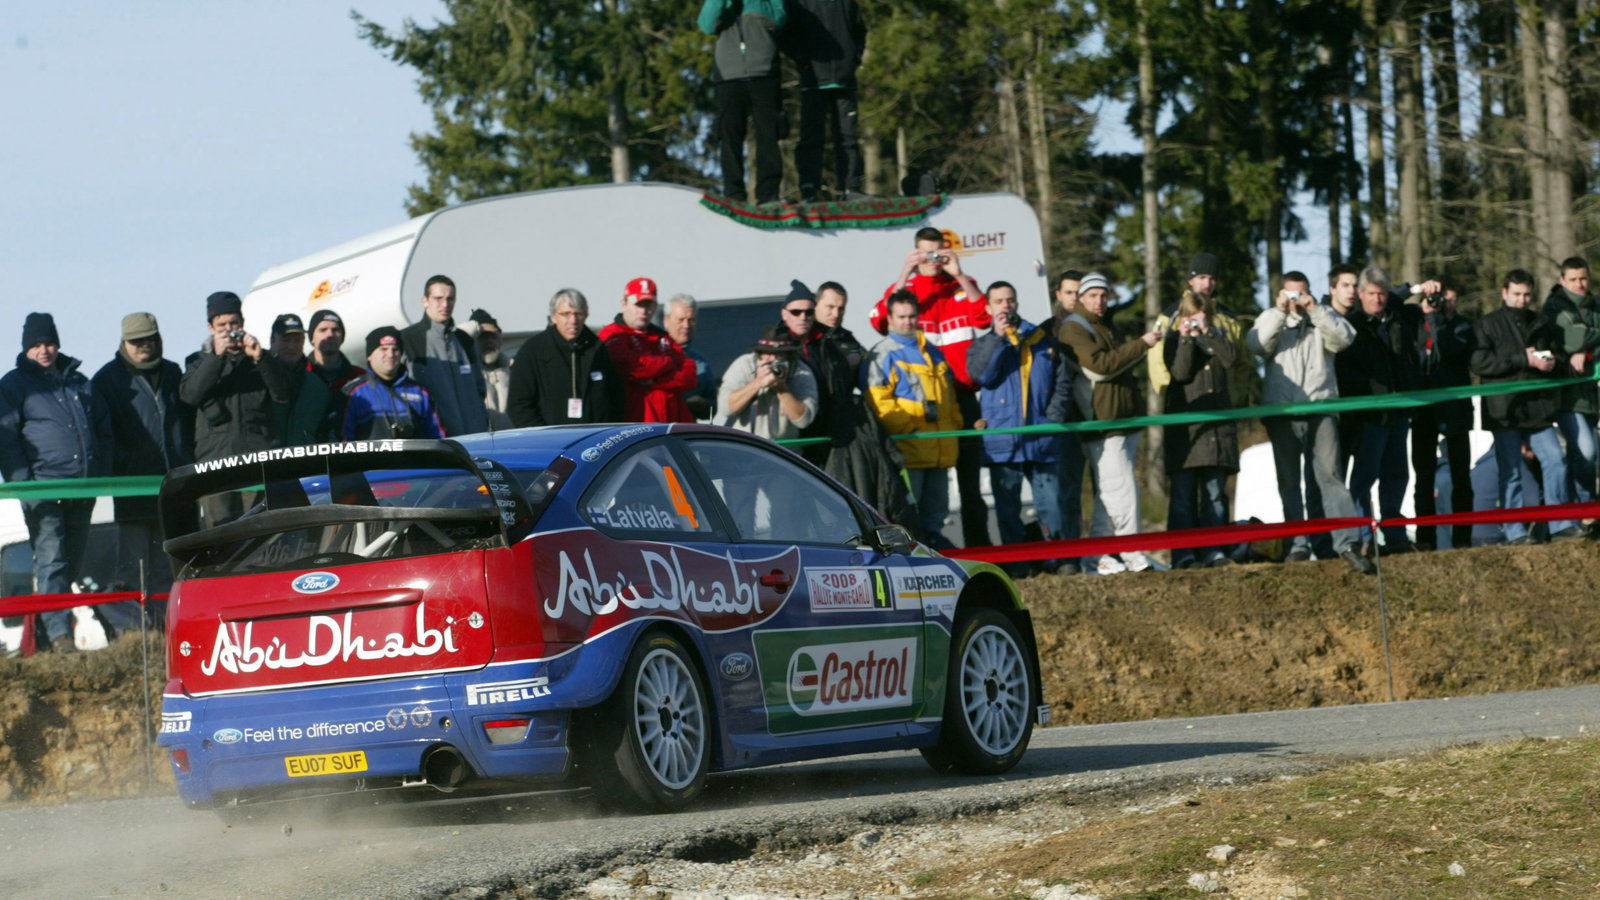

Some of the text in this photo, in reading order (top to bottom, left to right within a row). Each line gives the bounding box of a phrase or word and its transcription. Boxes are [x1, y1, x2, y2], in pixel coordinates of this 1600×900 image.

[942, 231, 1007, 249] S-LIGHT
[313, 274, 360, 300] S-LIGHT
[639, 280, 650, 293] 1
[194, 441, 404, 474] WWW.VISITABUDHABI.AE
[596, 439, 615, 452] Feel
[663, 465, 699, 529] 4
[605, 504, 676, 529] Latvala
[301, 574, 330, 591] Ford
[811, 577, 833, 606] RALLYE
[821, 573, 857, 589] 2008
[874, 569, 886, 608] 4
[725, 655, 748, 675] Ford
[819, 646, 908, 706] Castrol
[465, 676, 552, 706] PIRELLI
[243, 719, 386, 743] Feel the difference
[289, 753, 363, 775] EU07 SUF
